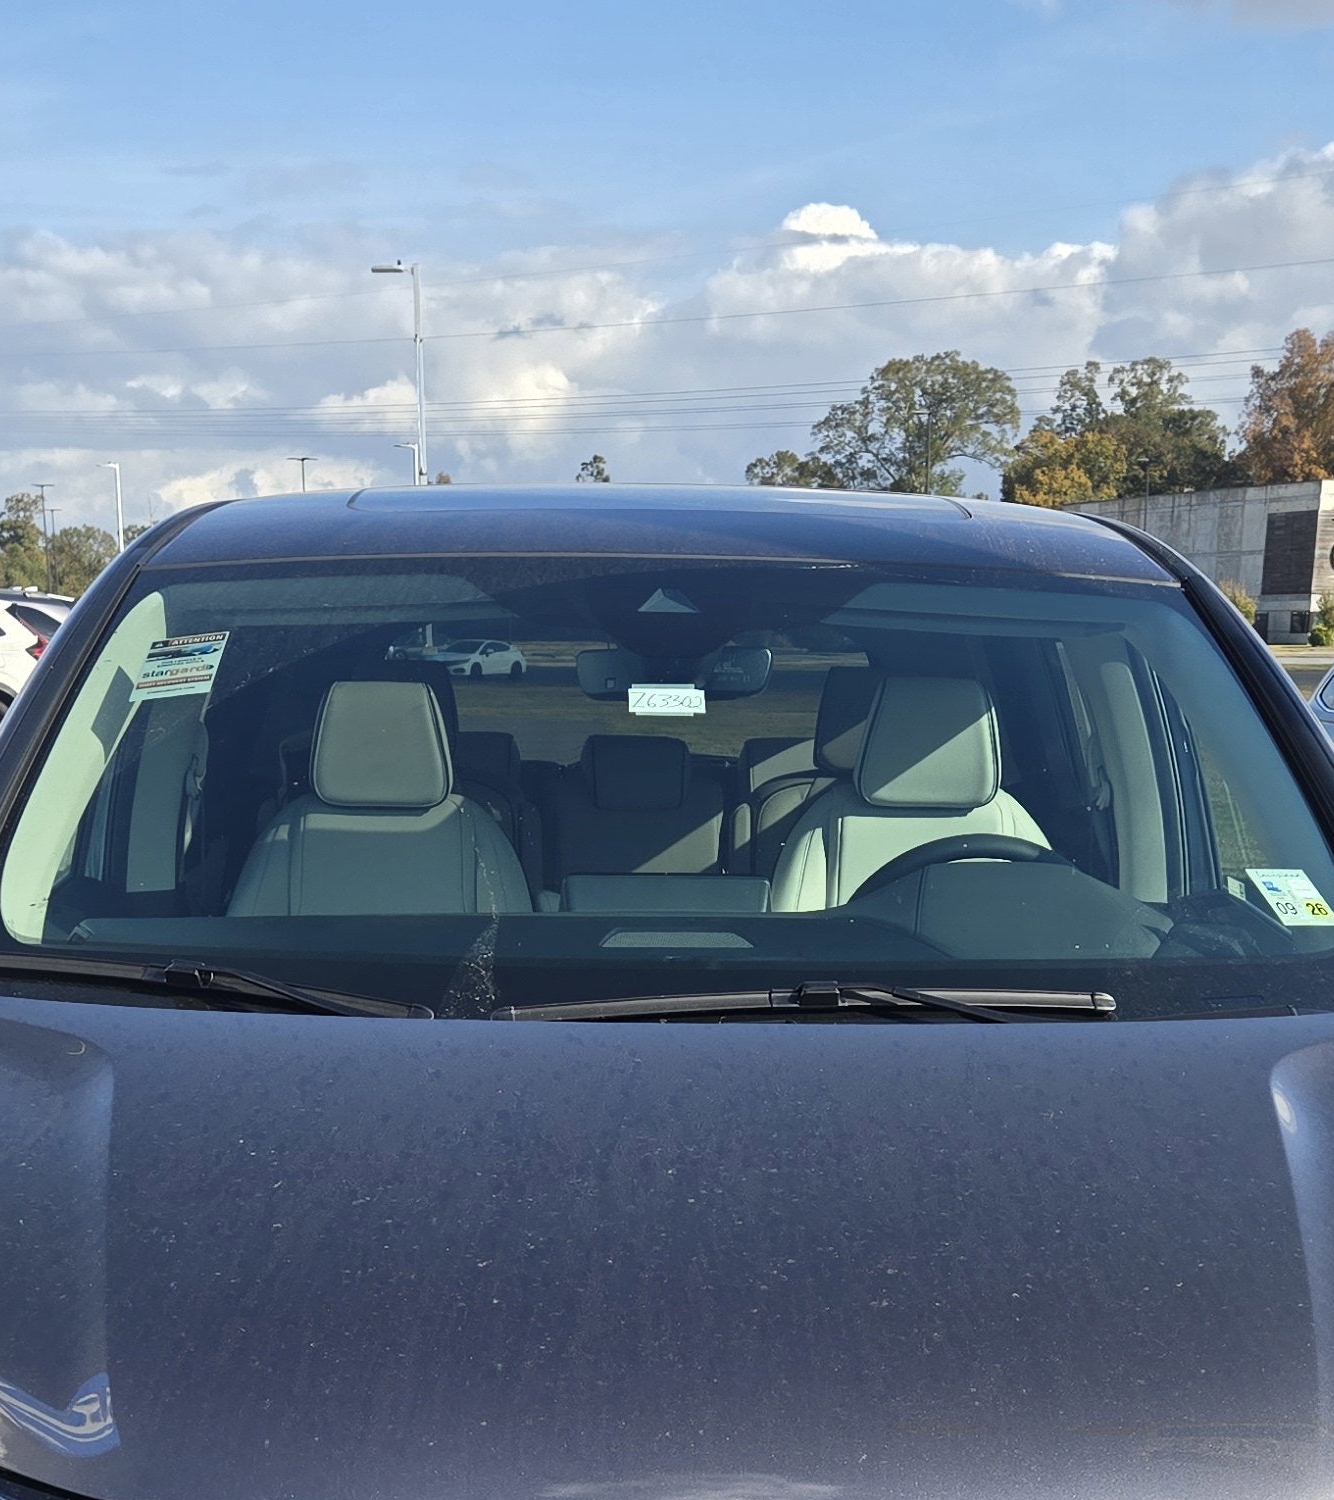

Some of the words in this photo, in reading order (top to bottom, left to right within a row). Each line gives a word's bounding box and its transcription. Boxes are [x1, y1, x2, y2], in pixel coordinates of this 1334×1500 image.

[171, 634, 224, 646] ATTENTION
[1275, 901, 1298, 915] 09
[1305, 902, 1329, 916] 26
